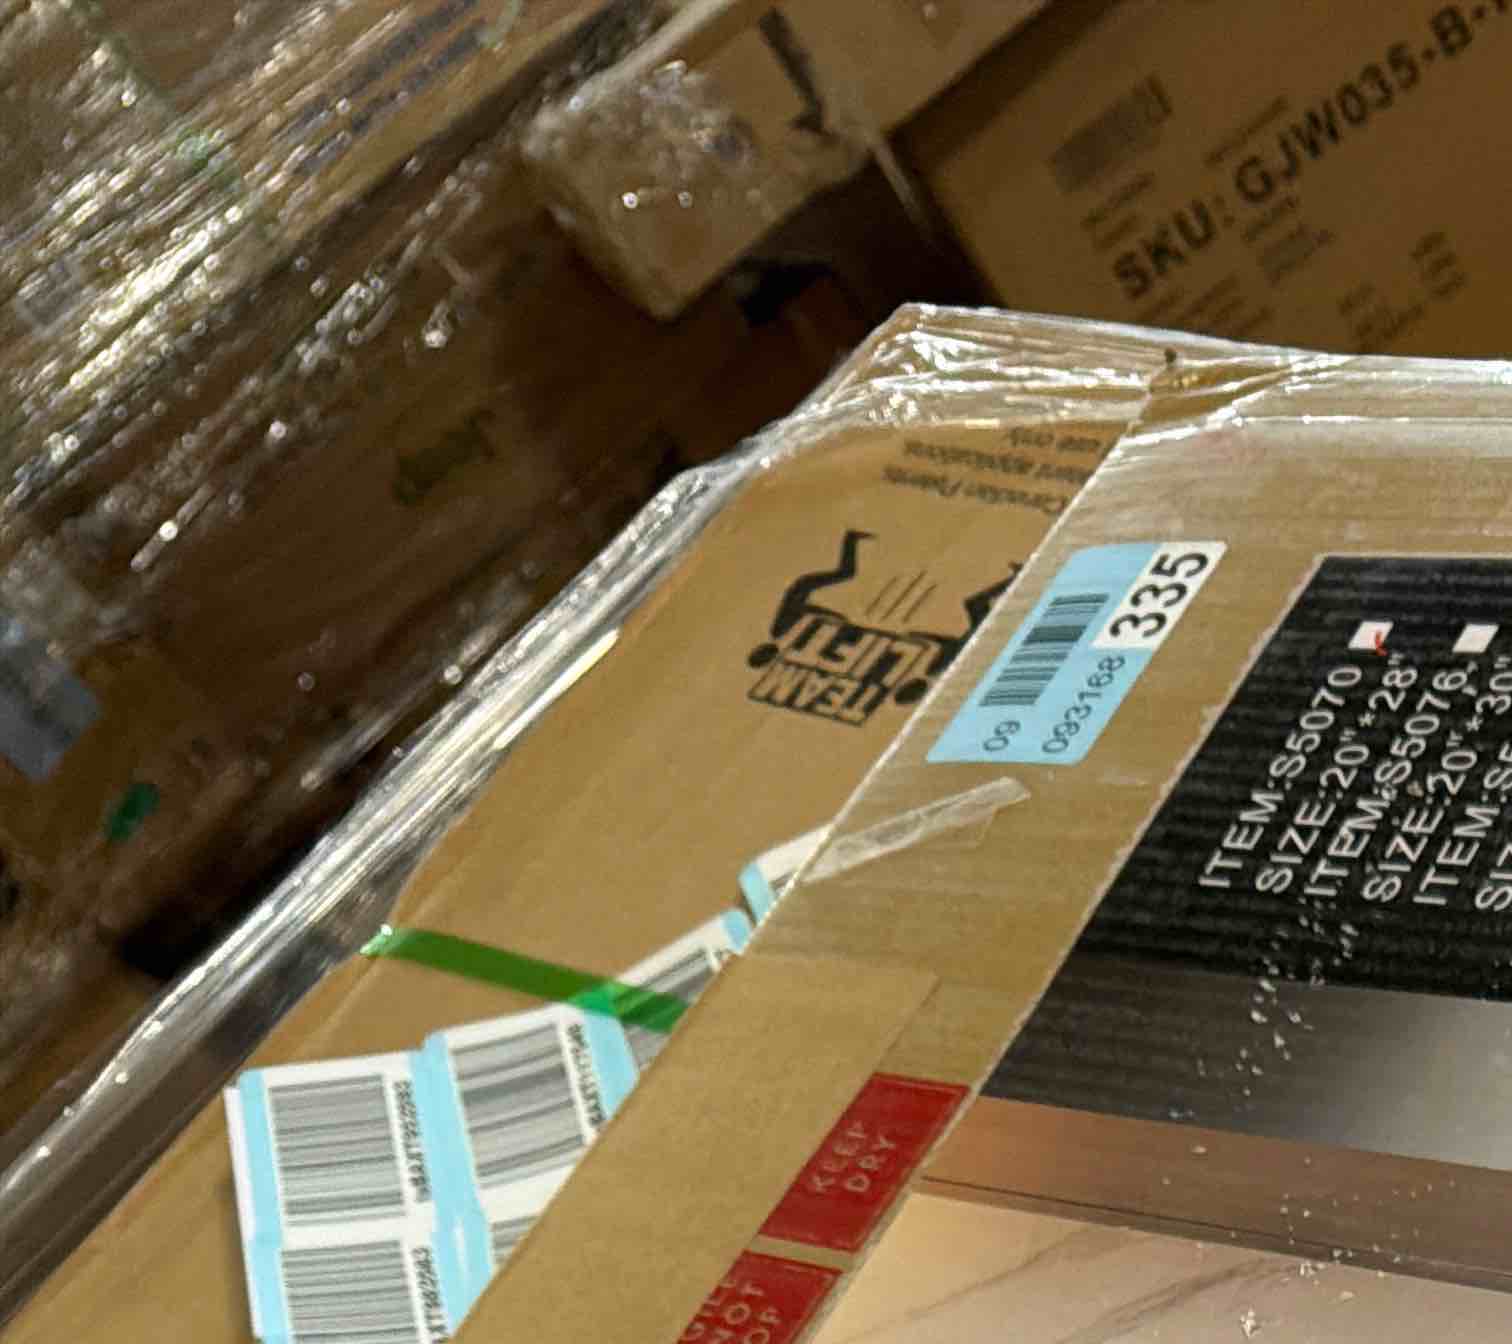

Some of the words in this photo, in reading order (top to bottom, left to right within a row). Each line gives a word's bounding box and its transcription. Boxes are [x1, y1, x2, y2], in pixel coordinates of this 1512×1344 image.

[1233, 0, 1510, 203] GJW035-B-
[1110, 552, 1210, 640] 335
[749, 672, 884, 724] TEAM
[983, 720, 1022, 753] 09
[1042, 655, 1126, 754] 093168
[1199, 666, 1362, 887] ITEM:S5070
[1304, 670, 1467, 895] ITEM:S5076
[811, 1120, 866, 1196] KEEP
[844, 1135, 898, 1193] DRY
